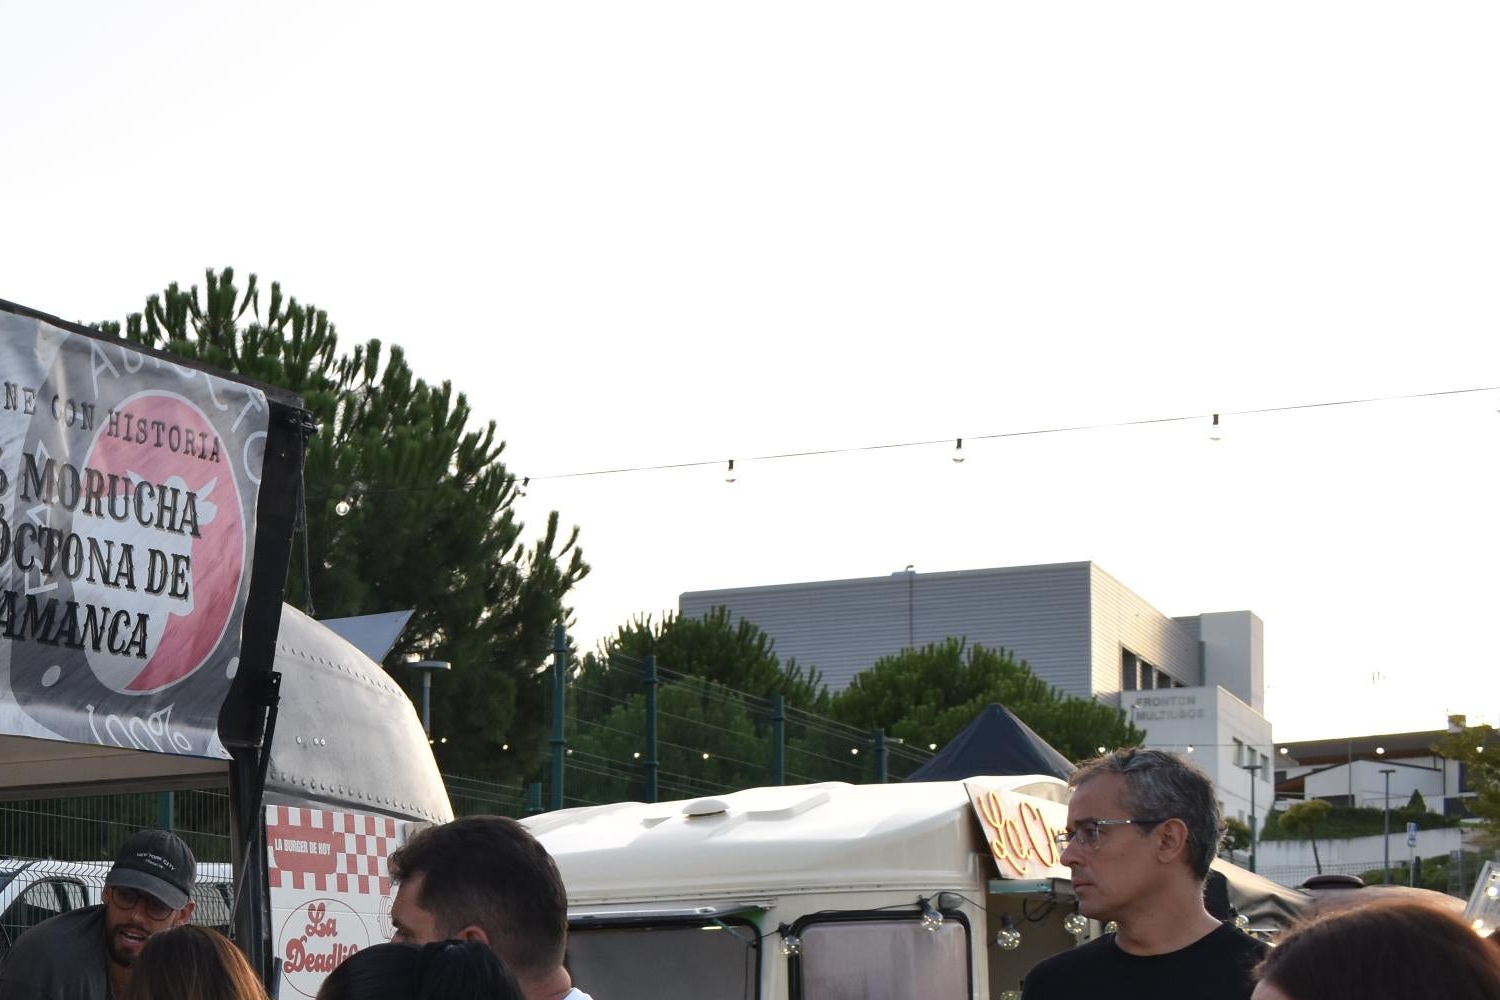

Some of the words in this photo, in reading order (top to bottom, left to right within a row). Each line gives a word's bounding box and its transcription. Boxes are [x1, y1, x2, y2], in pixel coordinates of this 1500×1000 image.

[51, 394, 96, 432] CON
[107, 407, 222, 464] HISTORIA
[19, 452, 202, 538] MORUCHA
[144, 548, 191, 601] DE
[274, 838, 283, 851] LA
[283, 839, 308, 854] BURGER
[309, 841, 317, 854] DE
[318, 842, 331, 855] HOY
[305, 902, 338, 937] La
